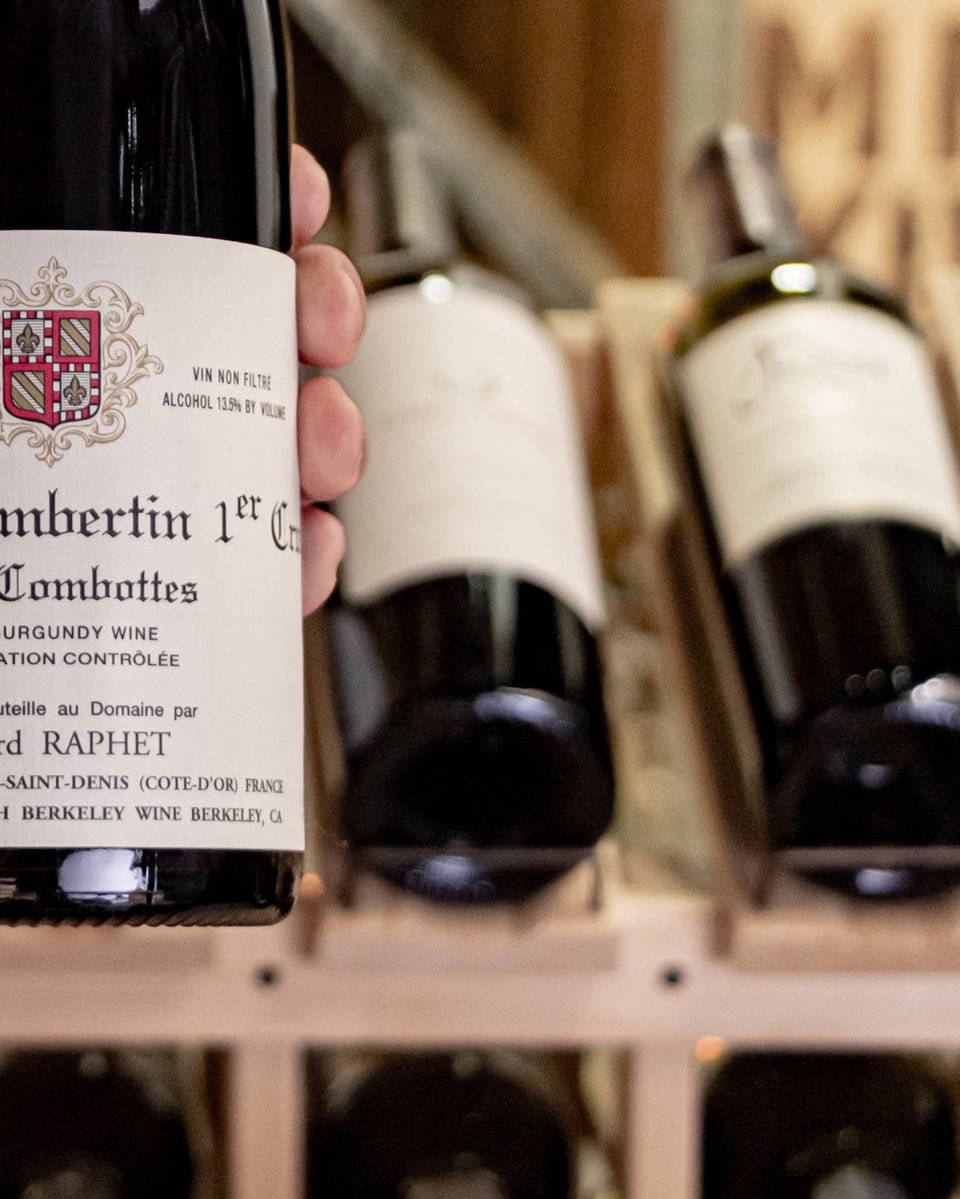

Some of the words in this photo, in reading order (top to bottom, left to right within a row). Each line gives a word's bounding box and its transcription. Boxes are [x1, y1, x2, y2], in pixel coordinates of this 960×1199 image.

[192, 366, 213, 382] VIN
[217, 369, 240, 385] NON
[162, 391, 213, 409] ALCOHOL
[245, 399, 256, 413] BY
[260, 402, 286, 420] VOLUME
[111, 626, 159, 641] WINE
[63, 649, 180, 667] CONTRÔLÉE
[57, 702, 80, 717] au
[90, 701, 165, 718] Domaine
[173, 704, 198, 721] par
[42, 730, 172, 757] RAPHET
[139, 774, 238, 794] (COTE-D'OR)
[245, 777, 284, 794] FRANCE
[21, 805, 125, 821] BERKELEY
[135, 805, 182, 821] WINE
[190, 807, 265, 826] BERKELEY,
[269, 808, 283, 823] CA
